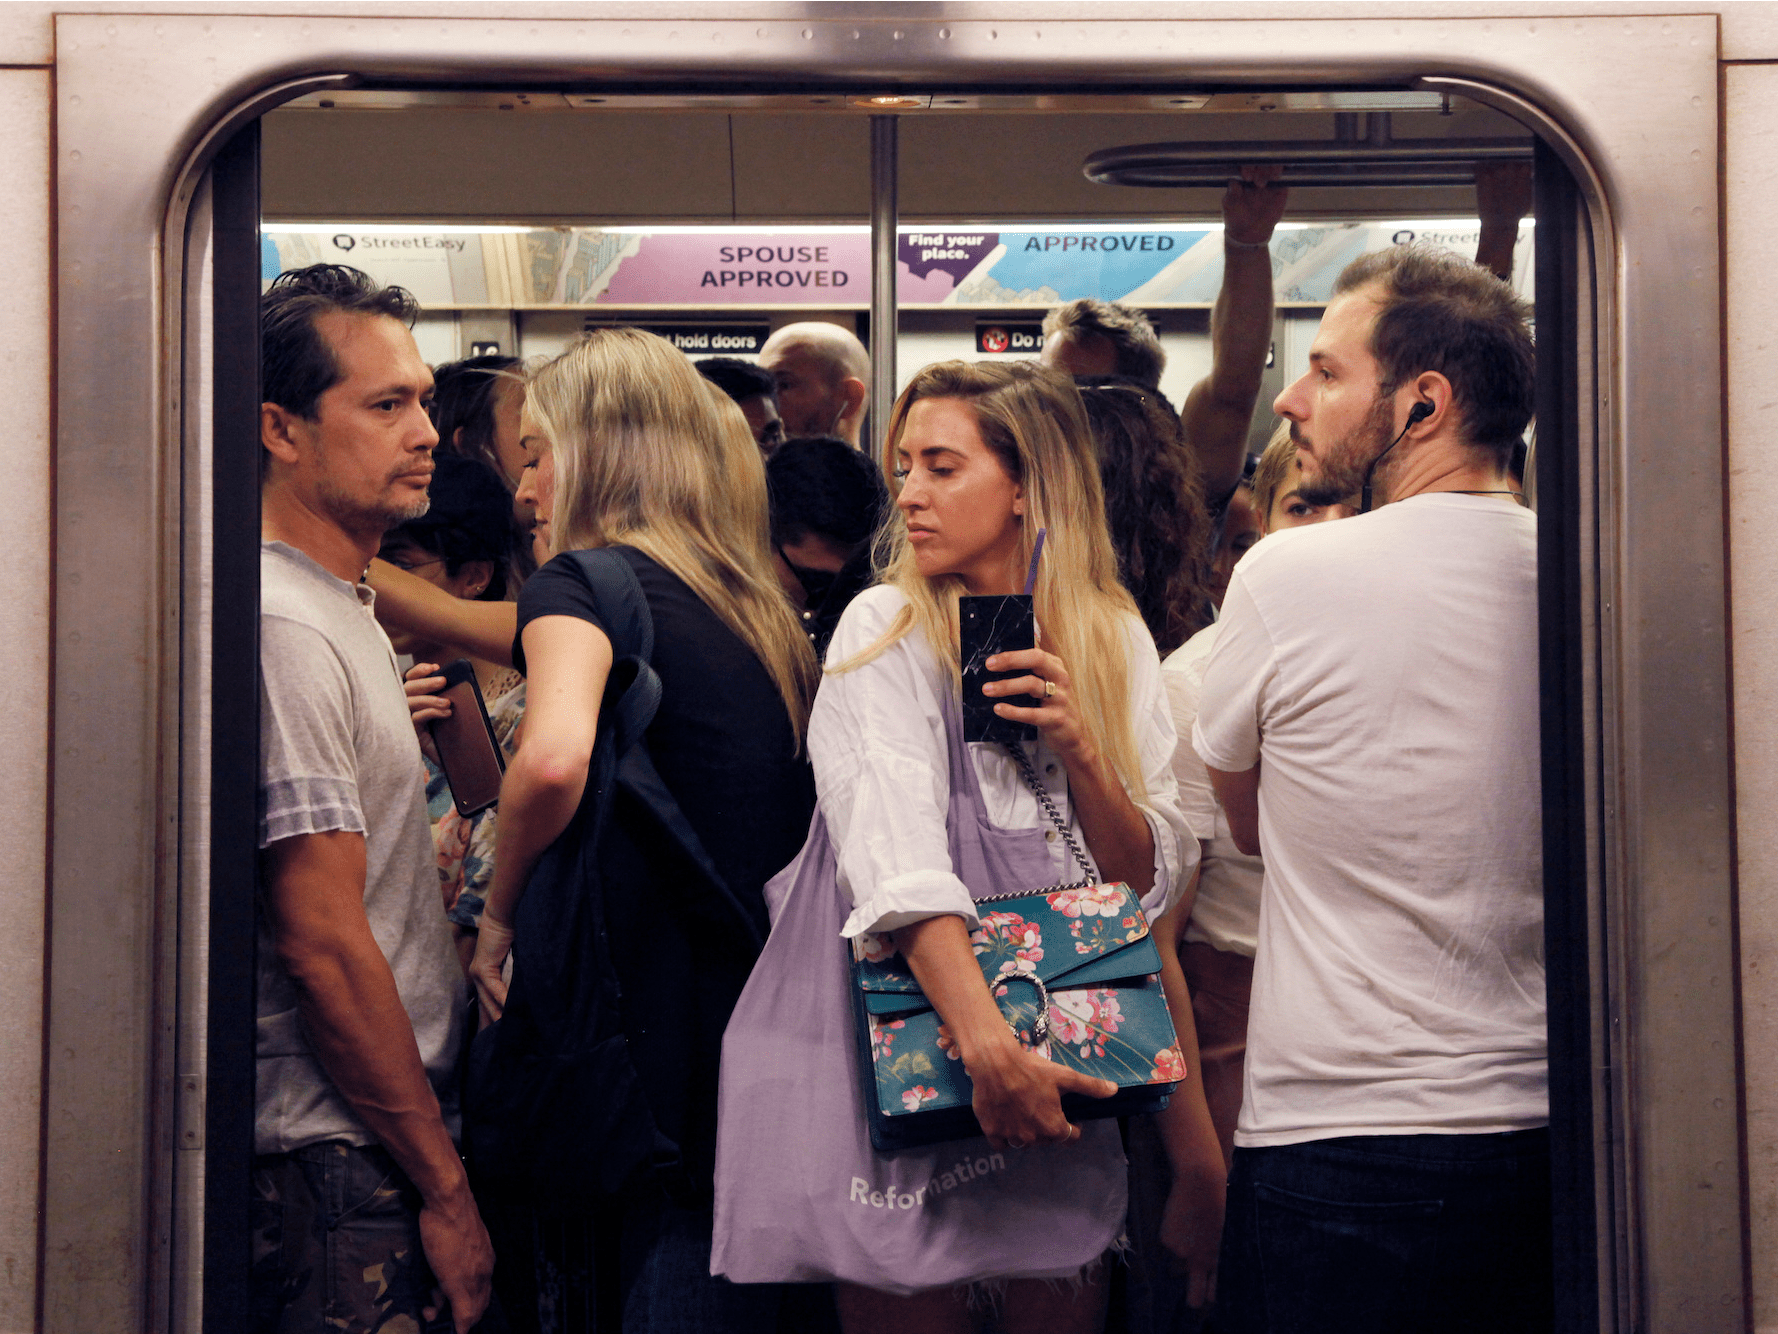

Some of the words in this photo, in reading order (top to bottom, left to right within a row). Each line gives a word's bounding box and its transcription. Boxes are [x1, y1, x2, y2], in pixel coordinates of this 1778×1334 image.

[361, 236, 465, 252] StreetEasy
[909, 234, 944, 246] Find
[947, 236, 985, 248] your
[1024, 235, 1175, 252] APPROVED
[720, 246, 829, 263] SPOUSE
[922, 247, 970, 262] place.
[700, 270, 849, 288] APPROVED
[674, 333, 709, 349] hold
[711, 333, 757, 349] doors
[1011, 332, 1034, 348] Do
